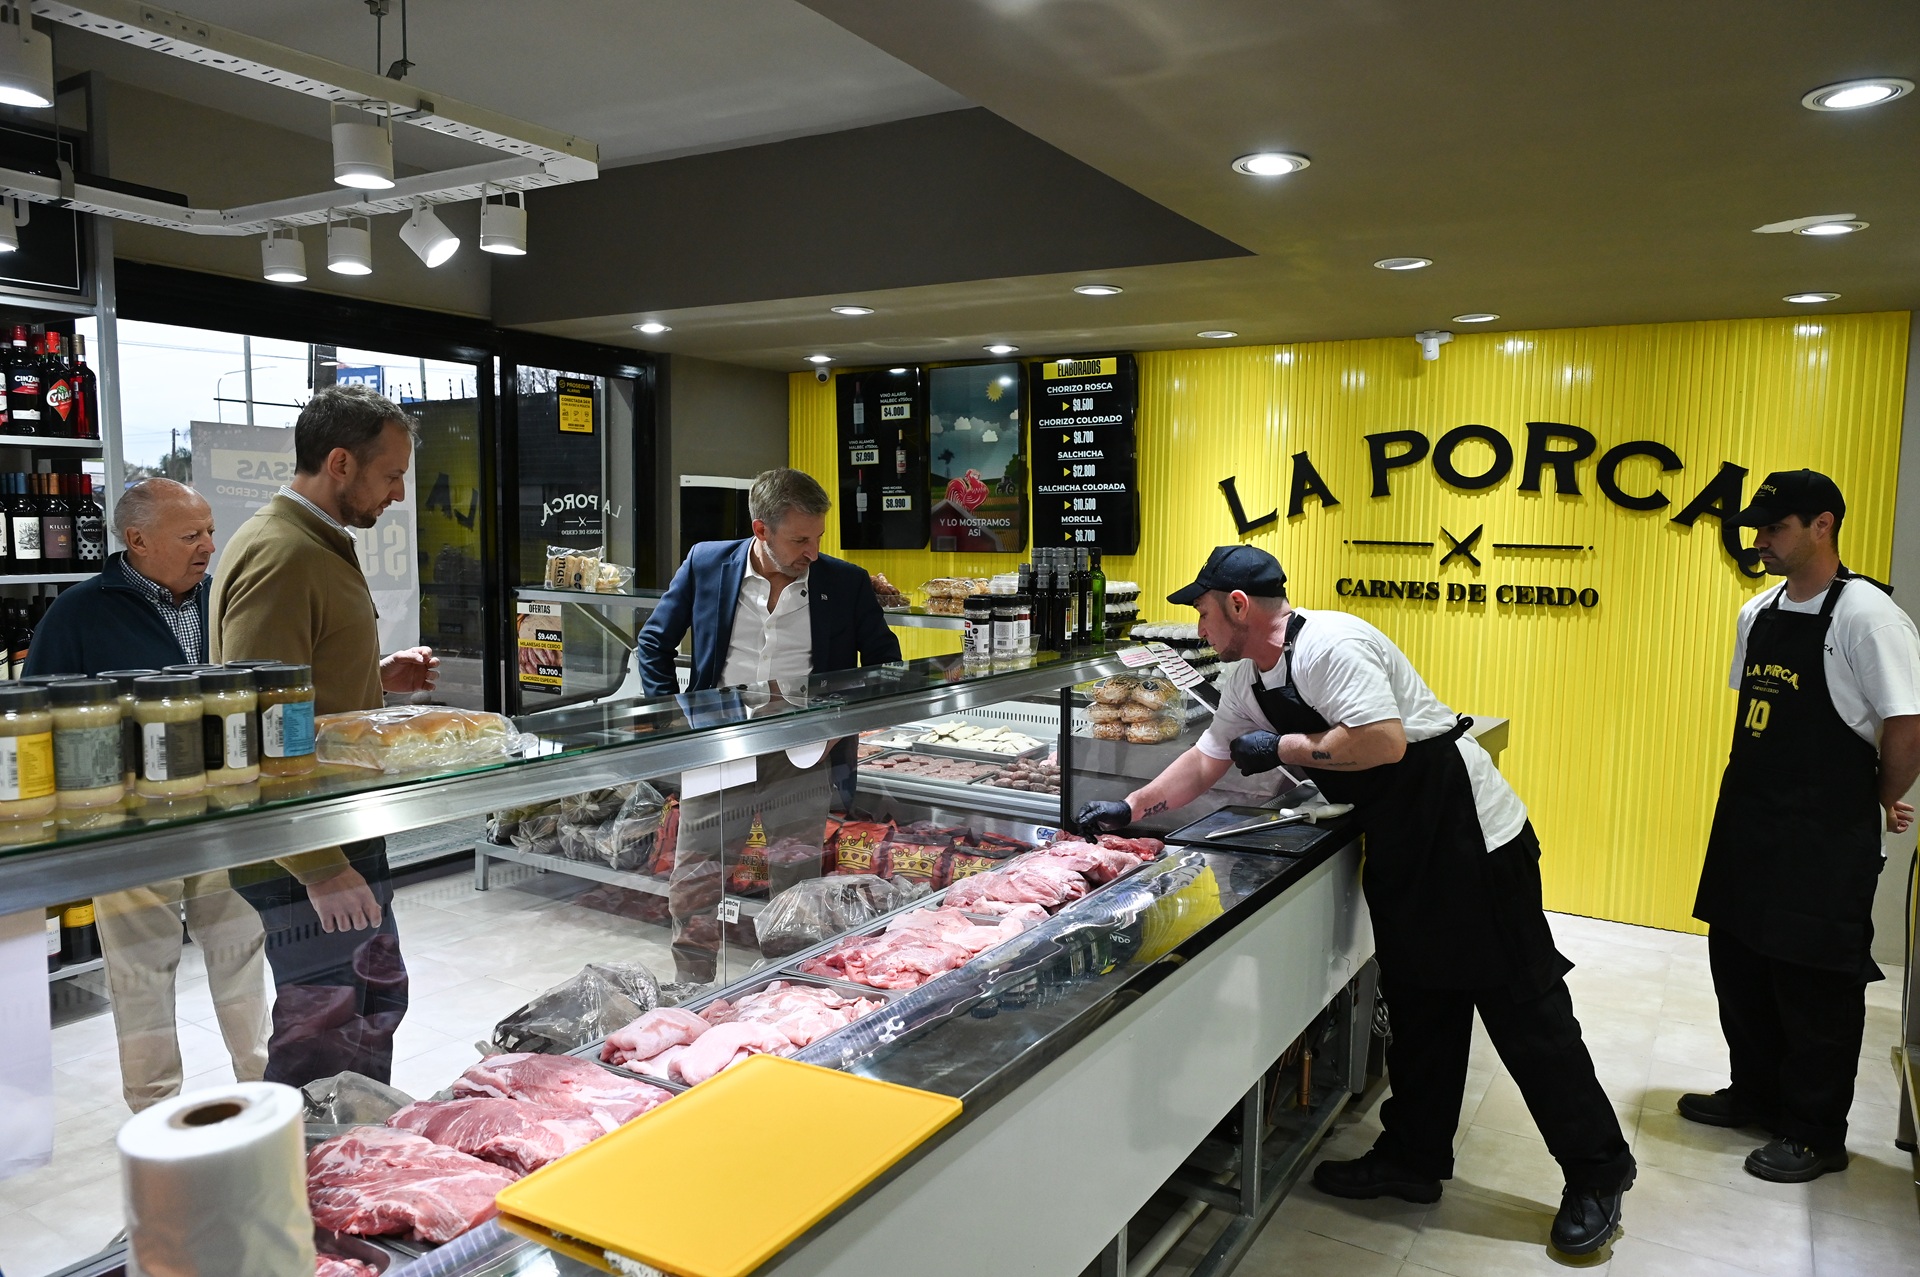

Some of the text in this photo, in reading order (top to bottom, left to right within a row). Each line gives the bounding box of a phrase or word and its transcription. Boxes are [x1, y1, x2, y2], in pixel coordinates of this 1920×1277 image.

[1057, 360, 1101, 377] ELABORADOS
[1046, 382, 1113, 394] CHORIZO ROSCA
[883, 406, 905, 417] $4.000
[1038, 414, 1123, 426] CHORIZO COLORADO
[1057, 450, 1104, 459] SALCHICHA
[1038, 483, 1126, 492] SALCHICHA COLORADA
[1219, 421, 1767, 579] LA PORCA
[947, 519, 957, 527] LO
[959, 518, 1011, 527] MOSTRAMOS
[1061, 515, 1103, 523] MORCILLA
[968, 526, 981, 537] ASÍ
[1336, 577, 1600, 608] CARNES DE CERDO
[528, 604, 551, 614] OFERTAS
[537, 632, 557, 641] $9.400
[538, 667, 558, 676] $9.700
[1746, 664, 1761, 677] LA
[1745, 698, 1771, 731] 10
